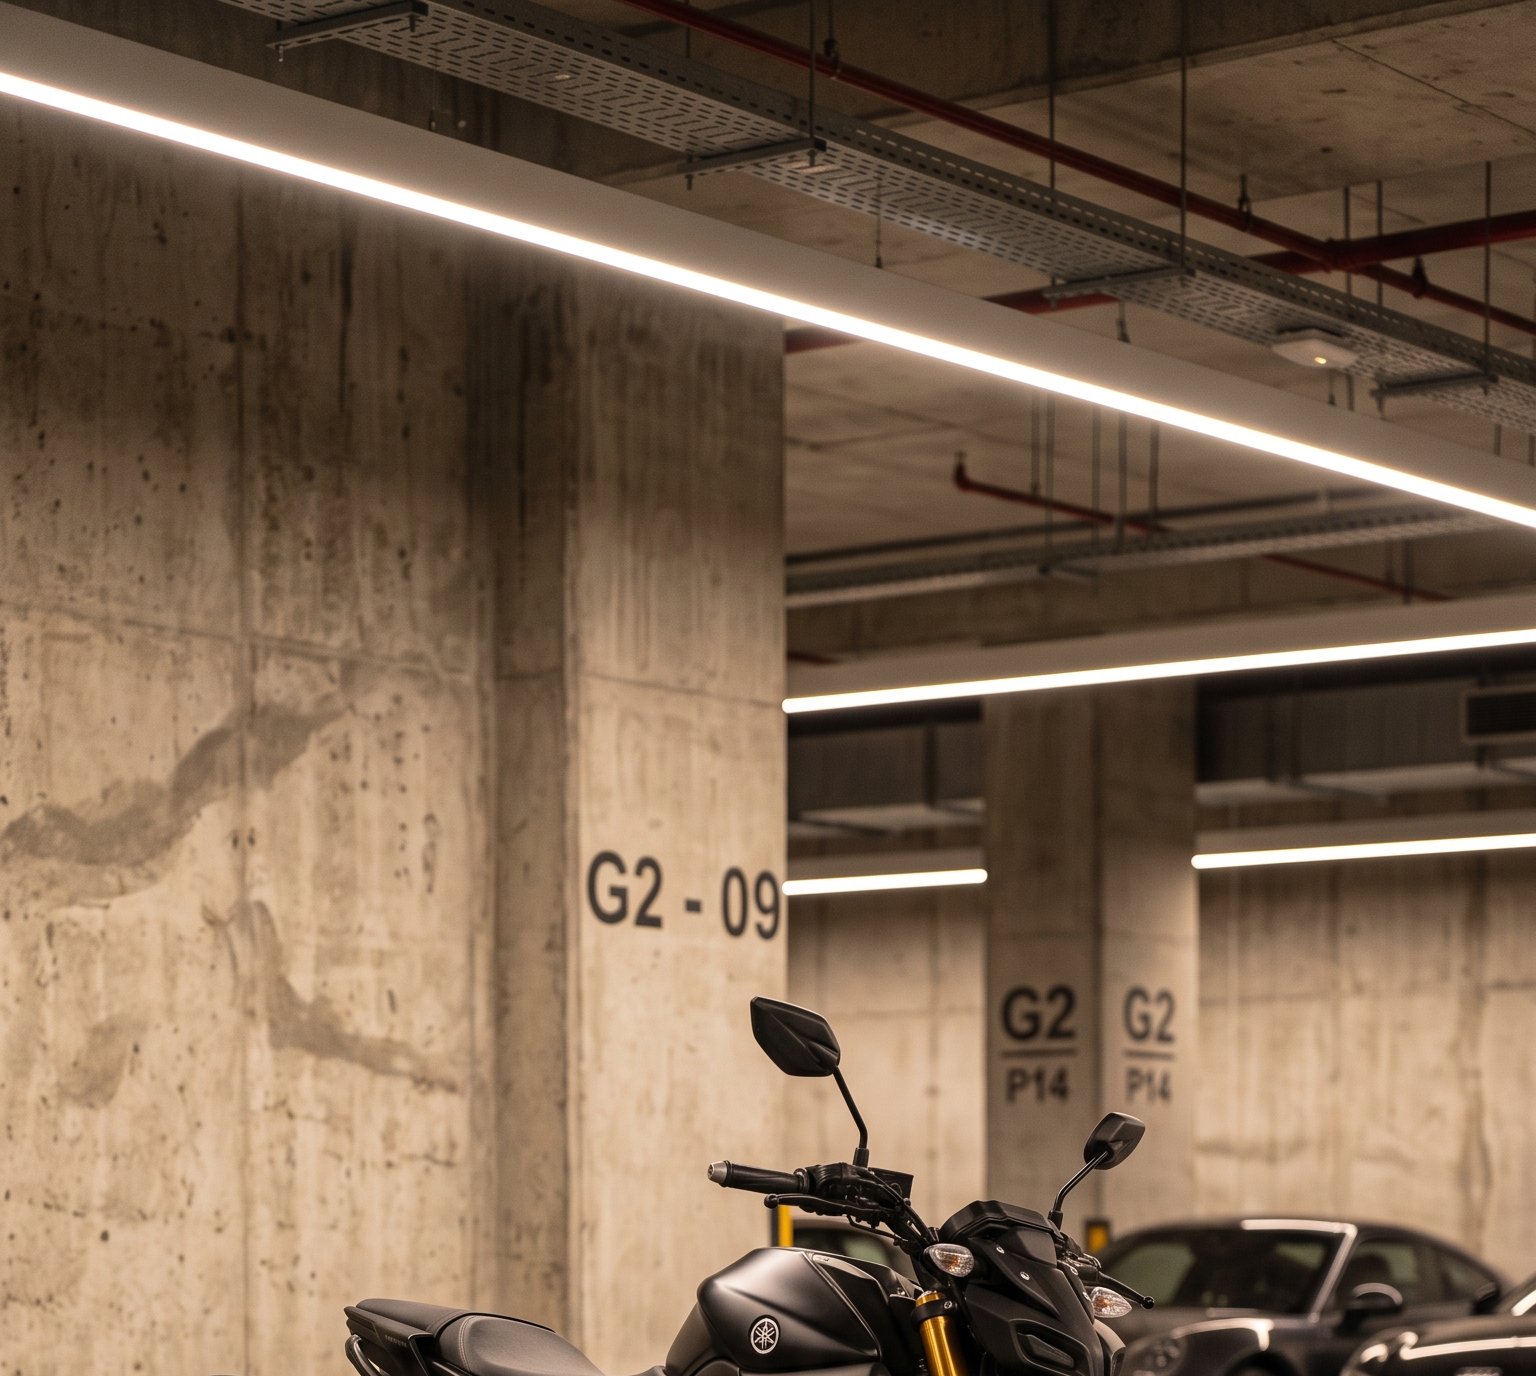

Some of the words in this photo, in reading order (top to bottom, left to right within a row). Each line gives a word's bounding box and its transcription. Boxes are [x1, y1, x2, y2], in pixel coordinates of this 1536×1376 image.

[587, 850, 663, 928] G2
[721, 866, 780, 940] 09
[1002, 984, 1075, 1041] G2
[1123, 986, 1175, 1042] G2
[1006, 1067, 1069, 1103] P14
[1125, 1067, 1171, 1102] P14
